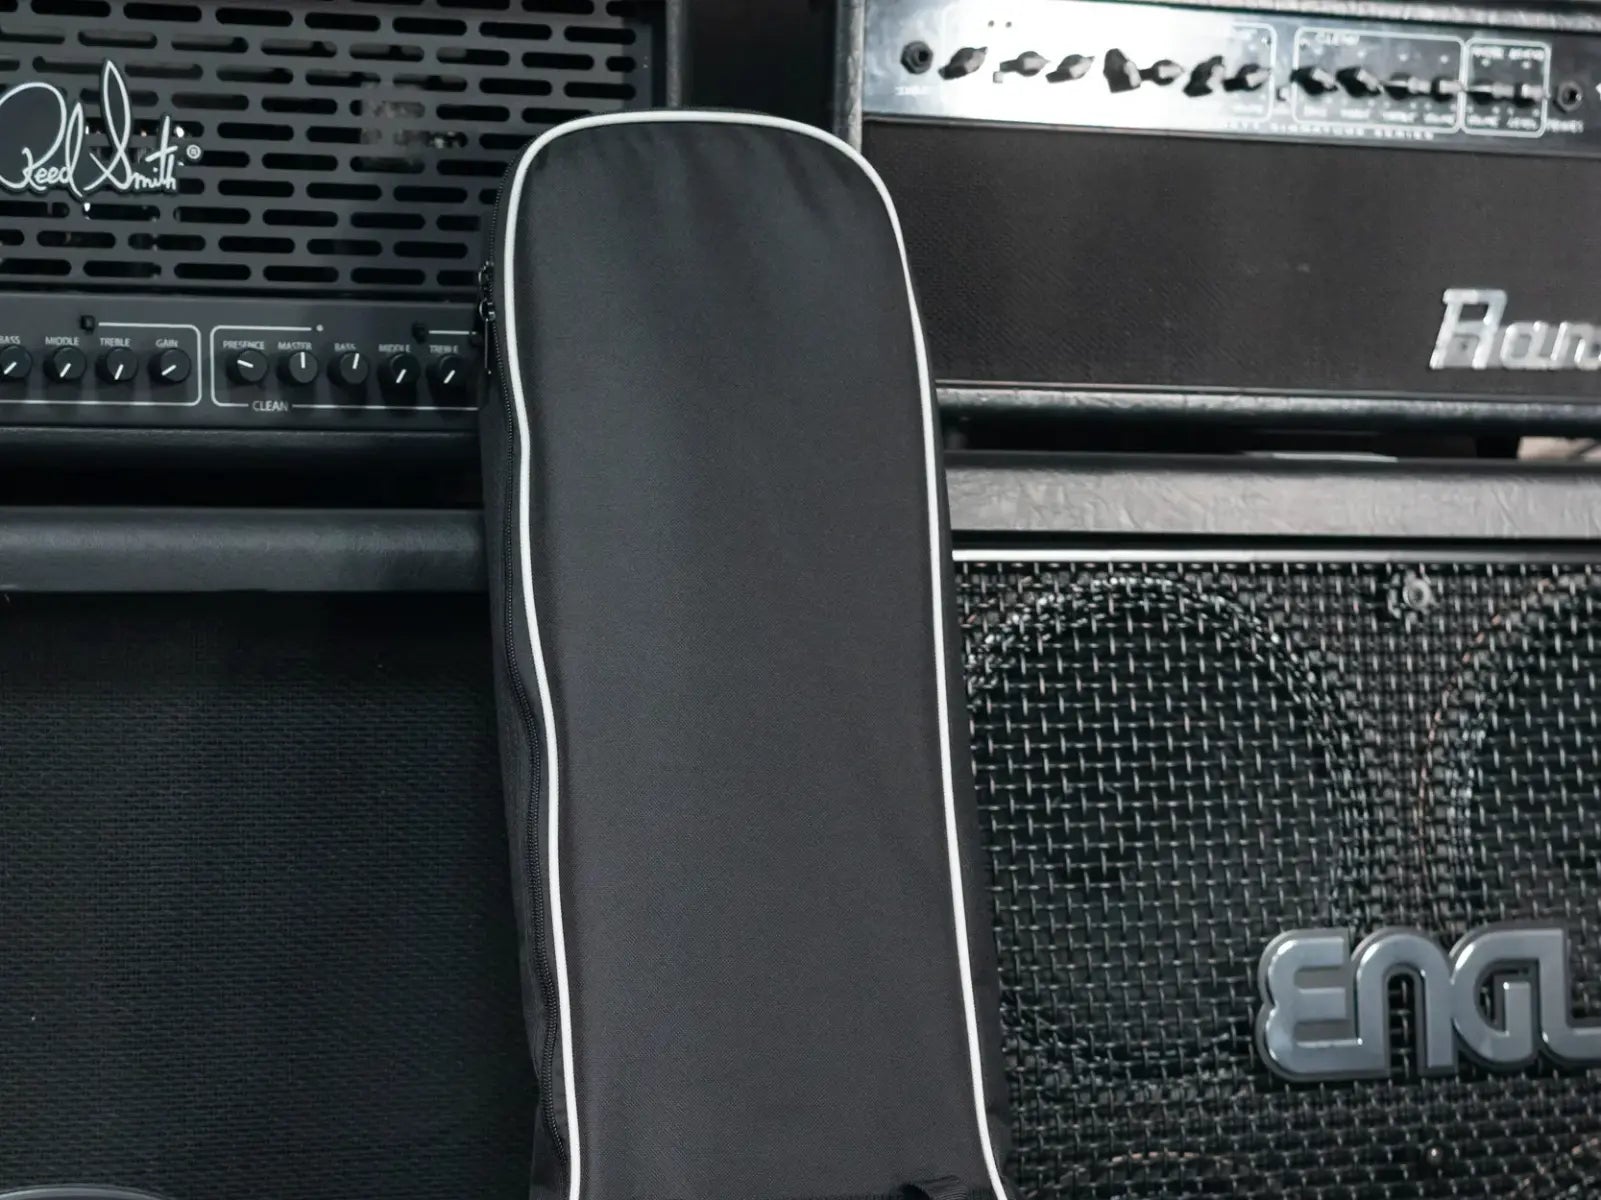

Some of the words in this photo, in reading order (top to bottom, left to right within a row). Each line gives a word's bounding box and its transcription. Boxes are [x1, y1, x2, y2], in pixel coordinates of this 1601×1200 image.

[44, 336, 80, 346] MIDDLE
[100, 337, 130, 347] TREBLE
[156, 338, 178, 348] GAIN
[223, 340, 264, 350] PRESENCE
[278, 341, 312, 350] MASTER
[252, 400, 288, 412] CLEAN
[1256, 926, 1601, 1082] ENGL
